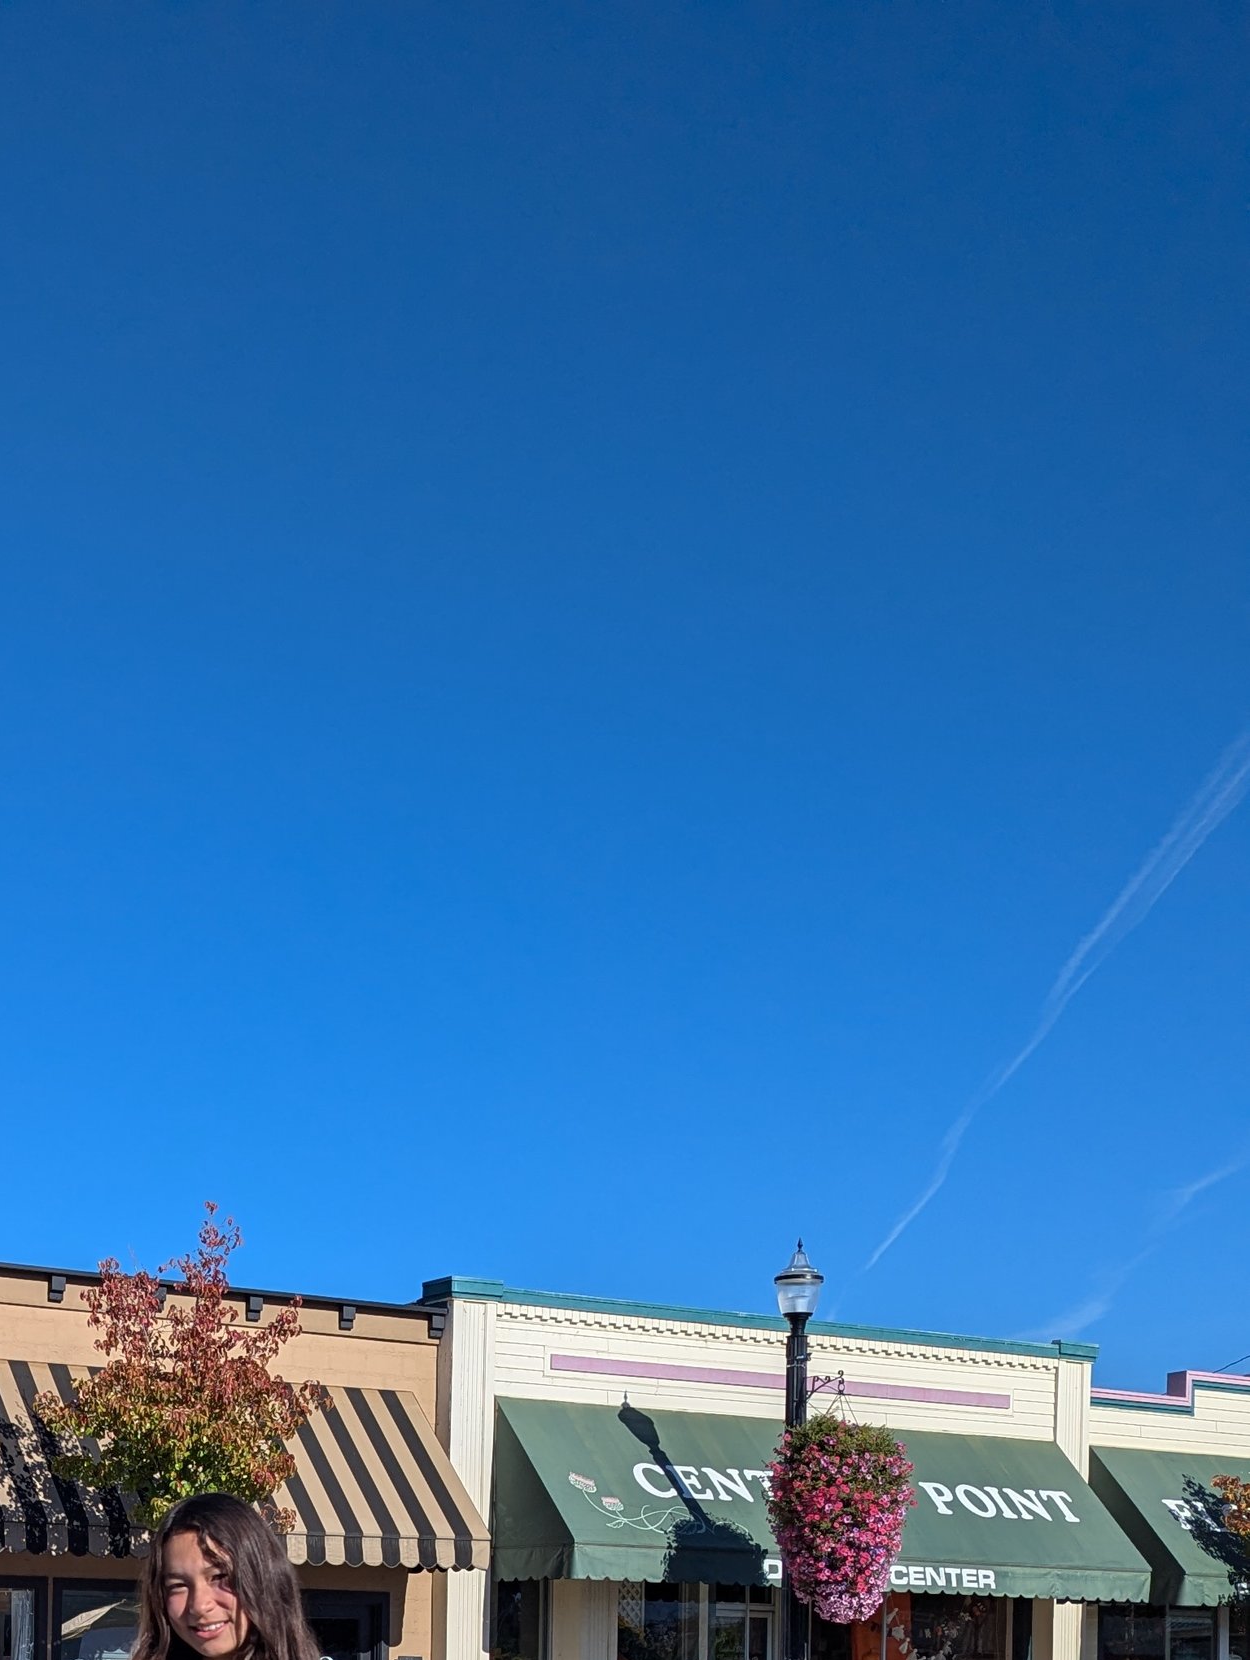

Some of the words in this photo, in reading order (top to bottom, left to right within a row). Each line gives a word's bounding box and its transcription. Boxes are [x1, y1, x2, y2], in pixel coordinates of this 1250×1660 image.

[632, 1462, 775, 1503] CENT
[918, 1480, 1081, 1523] POINT
[890, 1565, 996, 1590] CENTER
